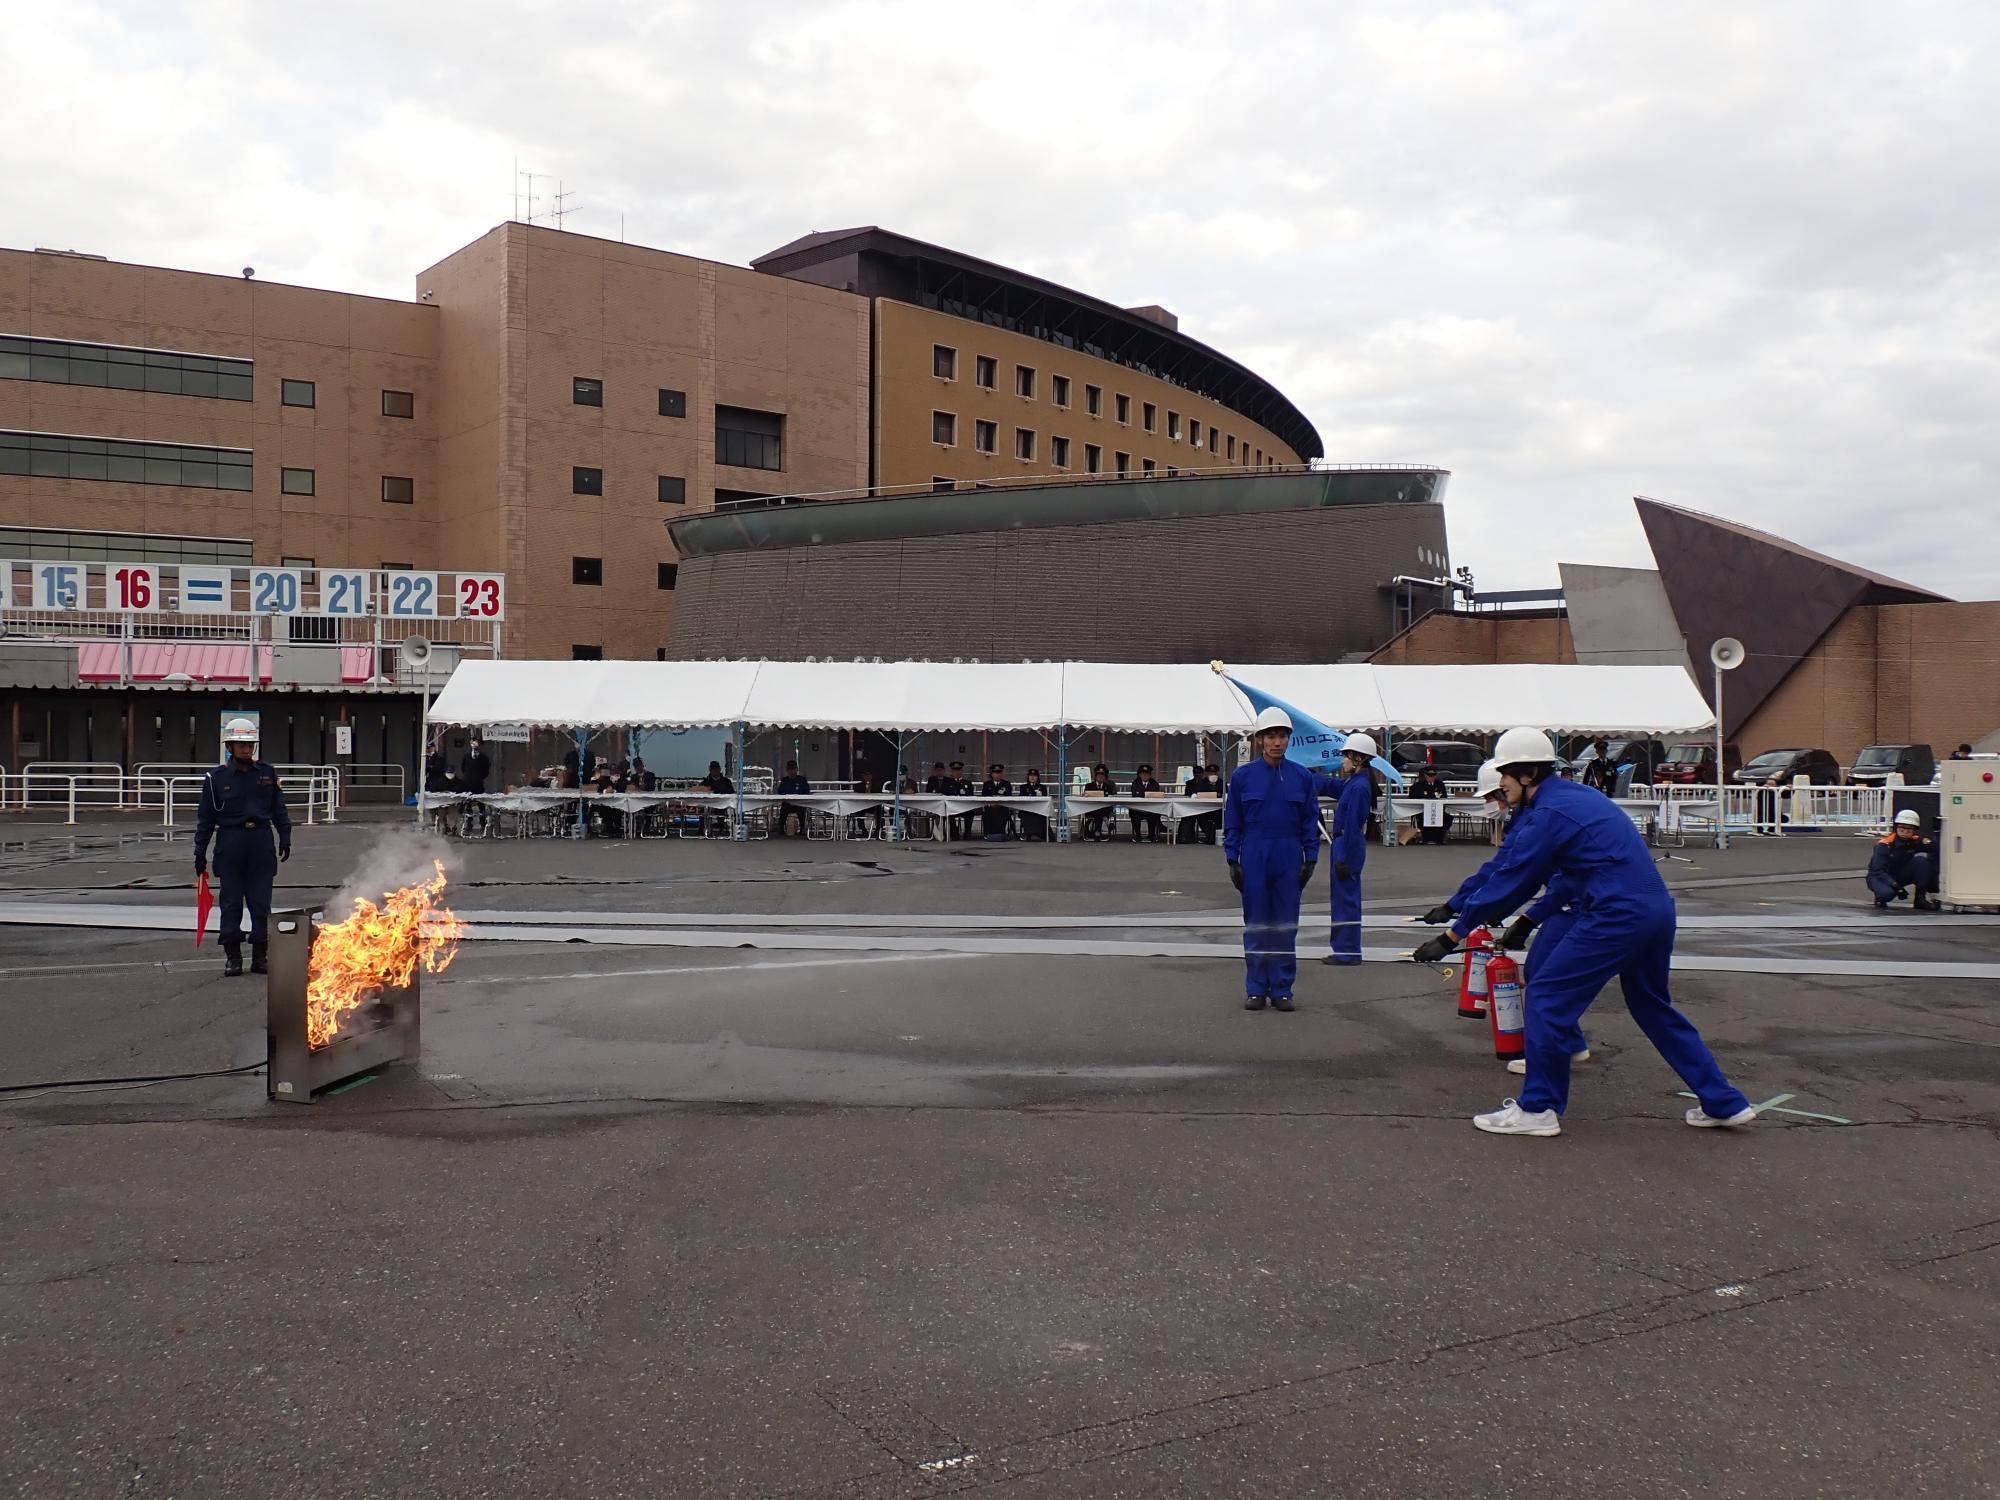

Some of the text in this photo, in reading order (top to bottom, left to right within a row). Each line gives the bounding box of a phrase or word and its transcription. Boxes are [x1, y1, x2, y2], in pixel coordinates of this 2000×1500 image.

[41, 566, 78, 608] 15
[115, 569, 150, 608] 16
[255, 572, 297, 613] 20
[328, 574, 362, 614] 21
[393, 576, 433, 616] 22
[461, 578, 500, 617] 23
